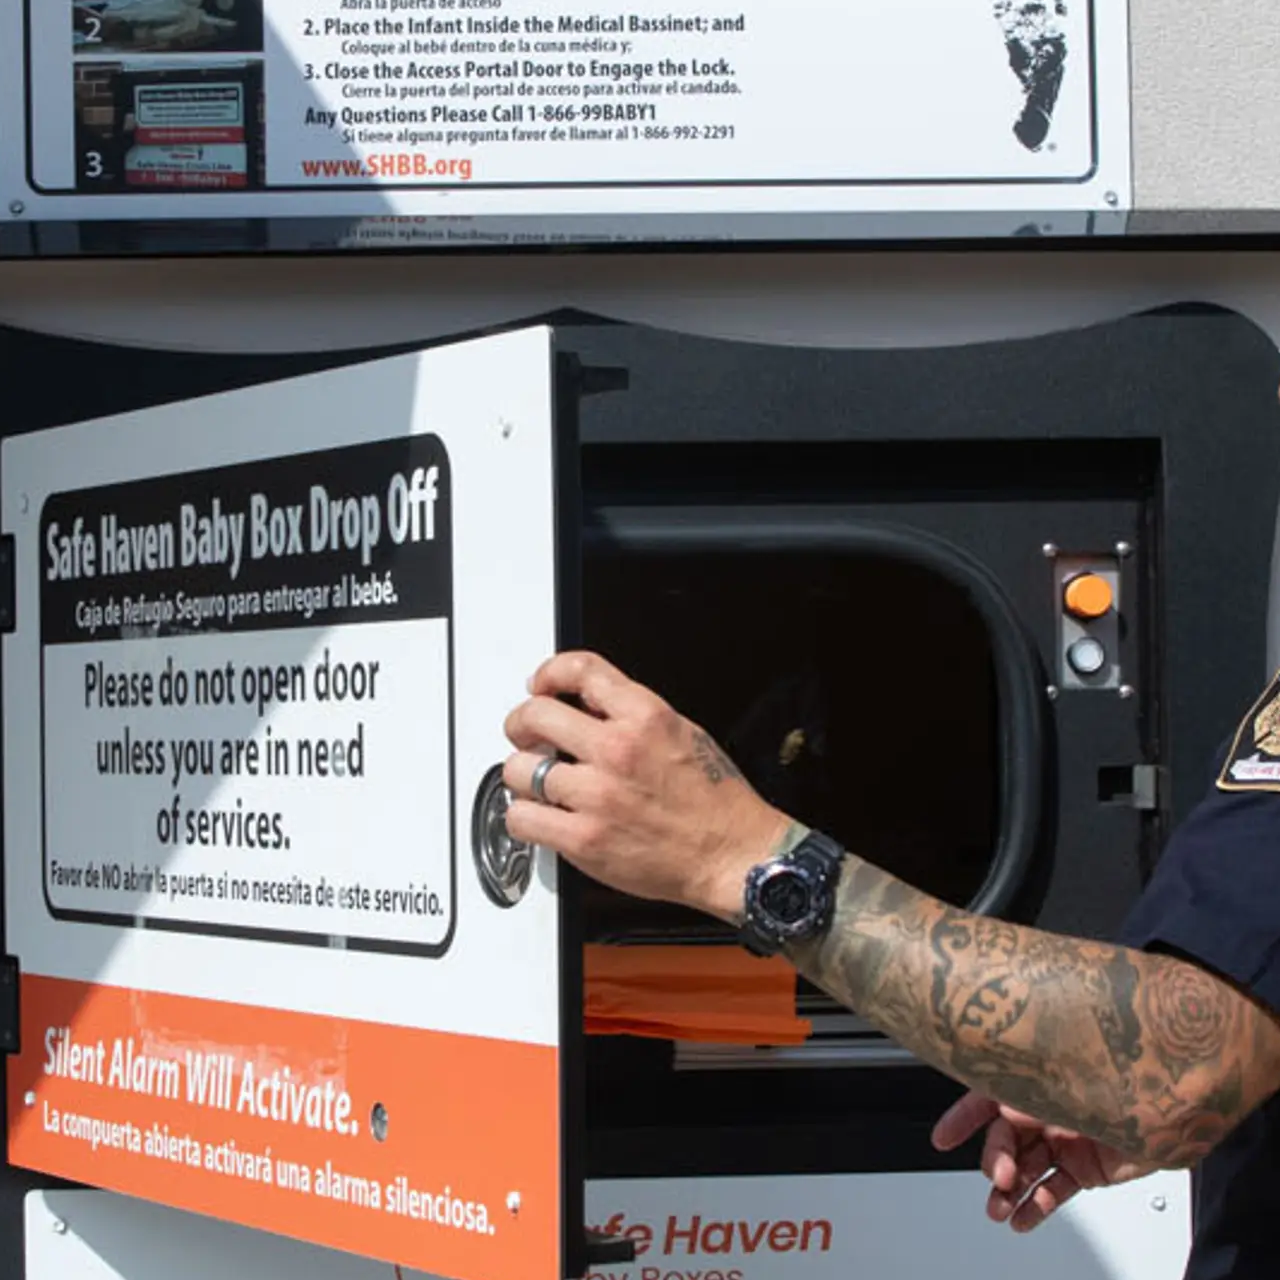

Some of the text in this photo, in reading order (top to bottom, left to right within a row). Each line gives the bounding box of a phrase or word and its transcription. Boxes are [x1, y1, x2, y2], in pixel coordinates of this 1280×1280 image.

[86, 18, 102, 44] 2
[304, 14, 744, 35] 2. Place the Infant Inside the Medical Bassinet; and
[305, 58, 735, 82] 3. Close the Access Portal Door to Engage the Lock.
[305, 103, 655, 128] Any Questions Please Call 1-866-99BABY1
[85, 151, 103, 178] 3
[302, 154, 472, 180] www.SHBB.org
[47, 465, 439, 580] Safe Haven Baby Box Drop Off
[76, 570, 398, 634] Caja de Refugio Seguro para entregar al bebé.
[85, 651, 379, 717] Please do not open door
[97, 722, 364, 787] unless you are in need
[157, 795, 290, 849] of services.
[44, 1027, 359, 1136] Silent Alarm Will Activate.
[43, 1101, 496, 1235] La compuerta abierta activará una alarma silenciosa.
[663, 1215, 833, 1255] Haven
